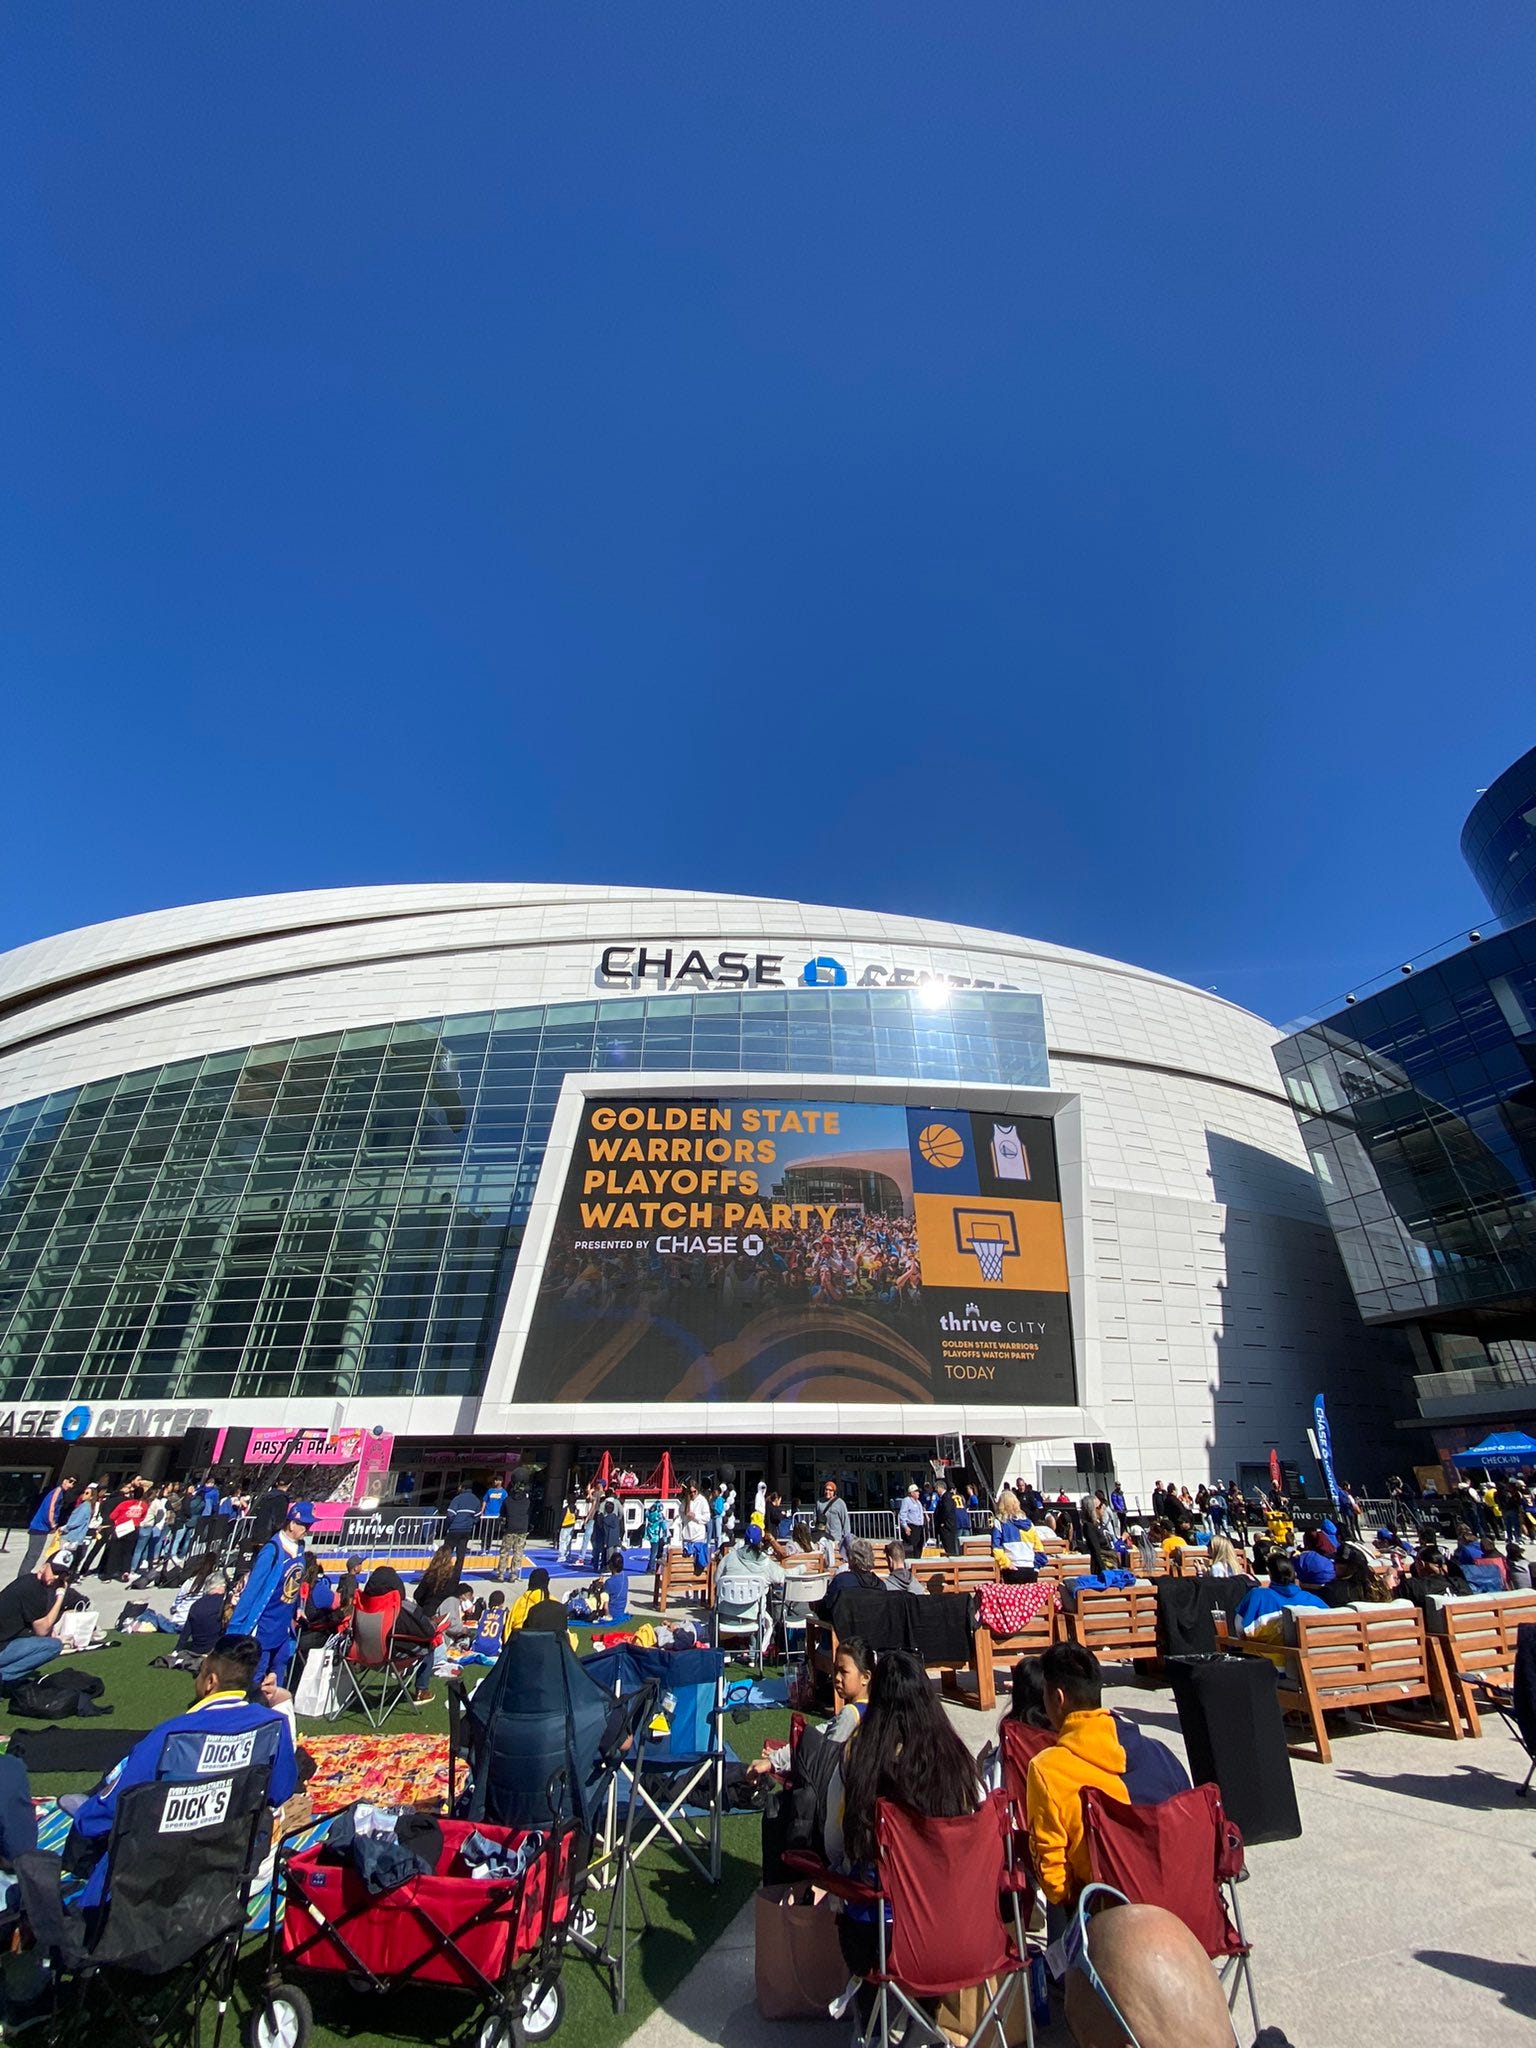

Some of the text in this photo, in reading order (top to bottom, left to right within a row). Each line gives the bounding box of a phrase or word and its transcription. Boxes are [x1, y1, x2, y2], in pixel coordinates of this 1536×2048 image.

[601, 946, 785, 987] CHASE
[591, 1107, 840, 1135] GOLDEN STATE
[588, 1138, 777, 1163] WARRIORS
[583, 1169, 759, 1195] PLAYOFFS
[580, 1202, 838, 1230] WATCH PARTY
[574, 1236, 739, 1254] PRESENTED BY CHASE
[940, 1311, 1046, 1334] thrive CITY
[941, 1340, 1039, 1351] GOLDEN STATE WARRIORS
[942, 1350, 1035, 1360] PLAYOFFS WATCH PARTY
[944, 1365, 996, 1380] TODAY
[0, 1408, 212, 1437] ASE CENTER
[1481, 1456, 1520, 1465] CHECK-IN
[348, 1519, 420, 1535] thrive CIT
[481, 1620, 499, 1638] 30
